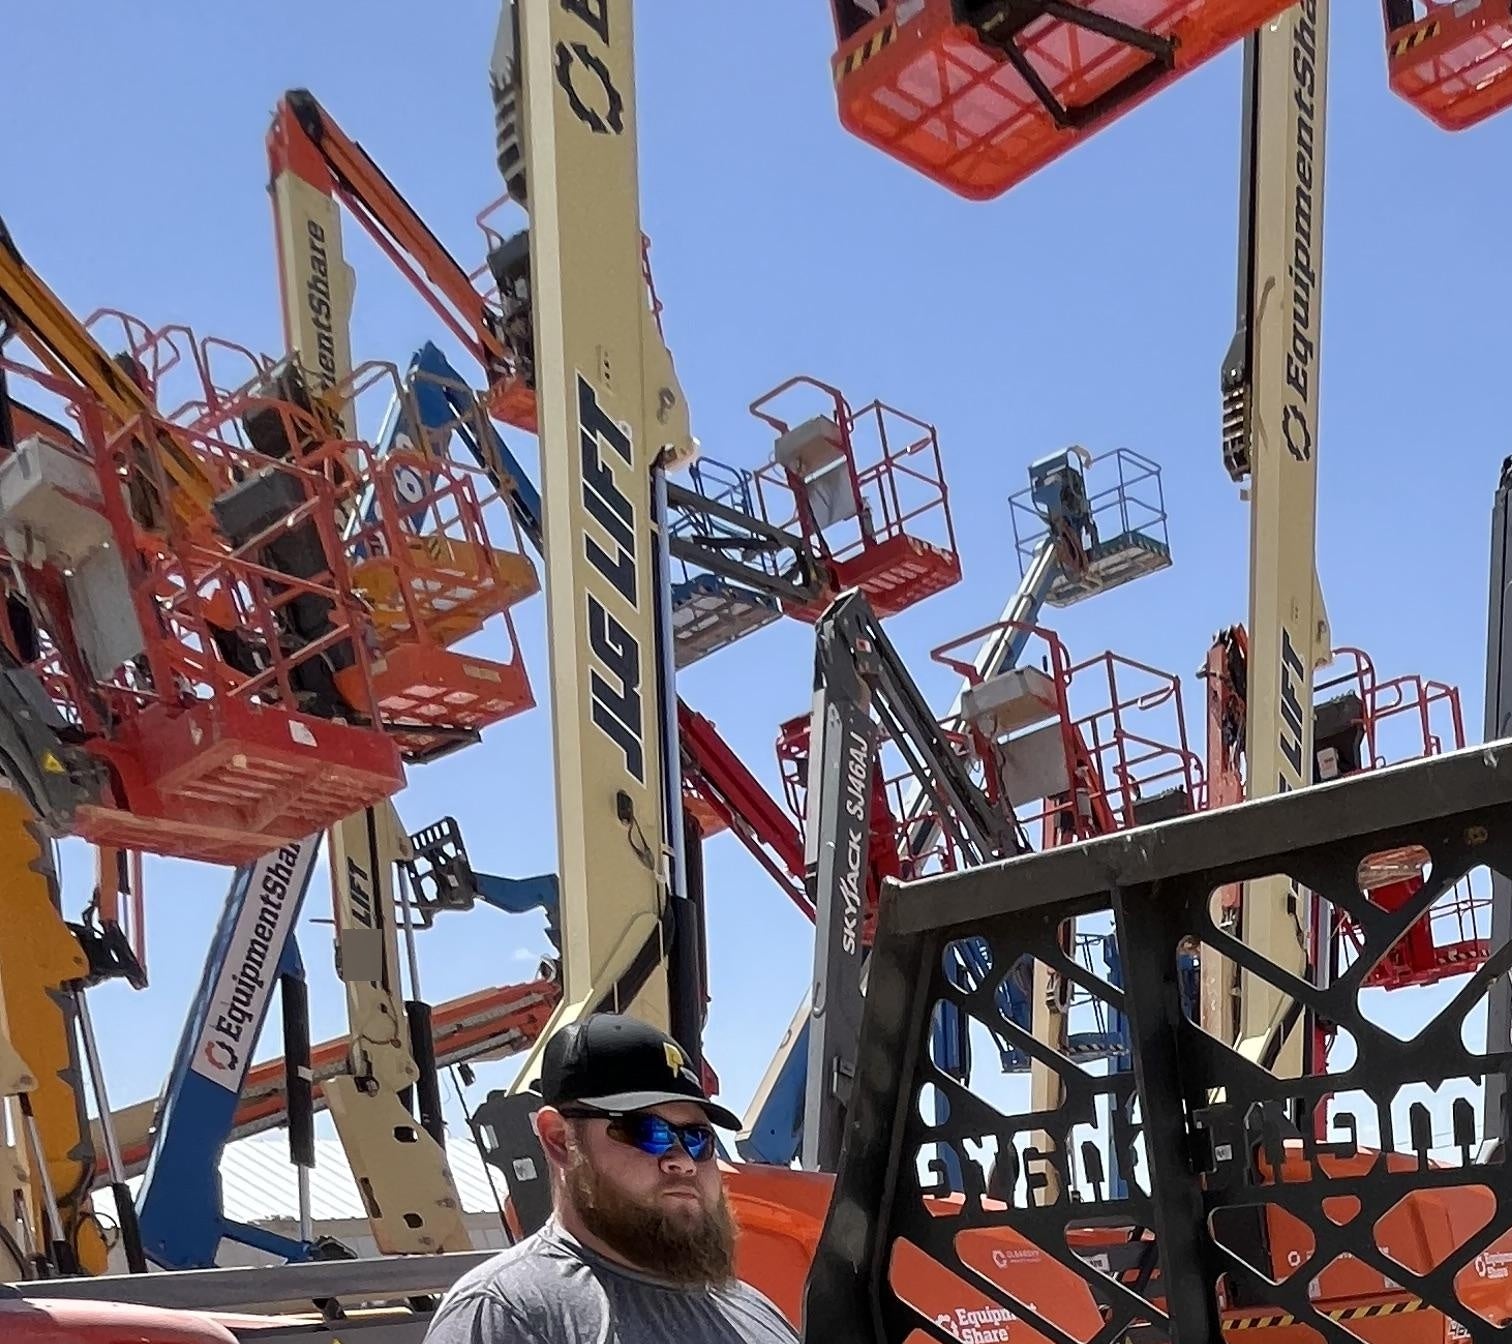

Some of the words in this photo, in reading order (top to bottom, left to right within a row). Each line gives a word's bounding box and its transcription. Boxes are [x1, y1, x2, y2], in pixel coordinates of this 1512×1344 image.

[575, 368, 641, 614] LIFT
[585, 587, 647, 788] JLG
[1279, 626, 1304, 778] LIFT
[846, 731, 869, 822] SJ46AJ
[215, 842, 301, 1042] EquipmentSha
[347, 856, 371, 929] LIFT
[840, 828, 863, 955] SKYJACK
